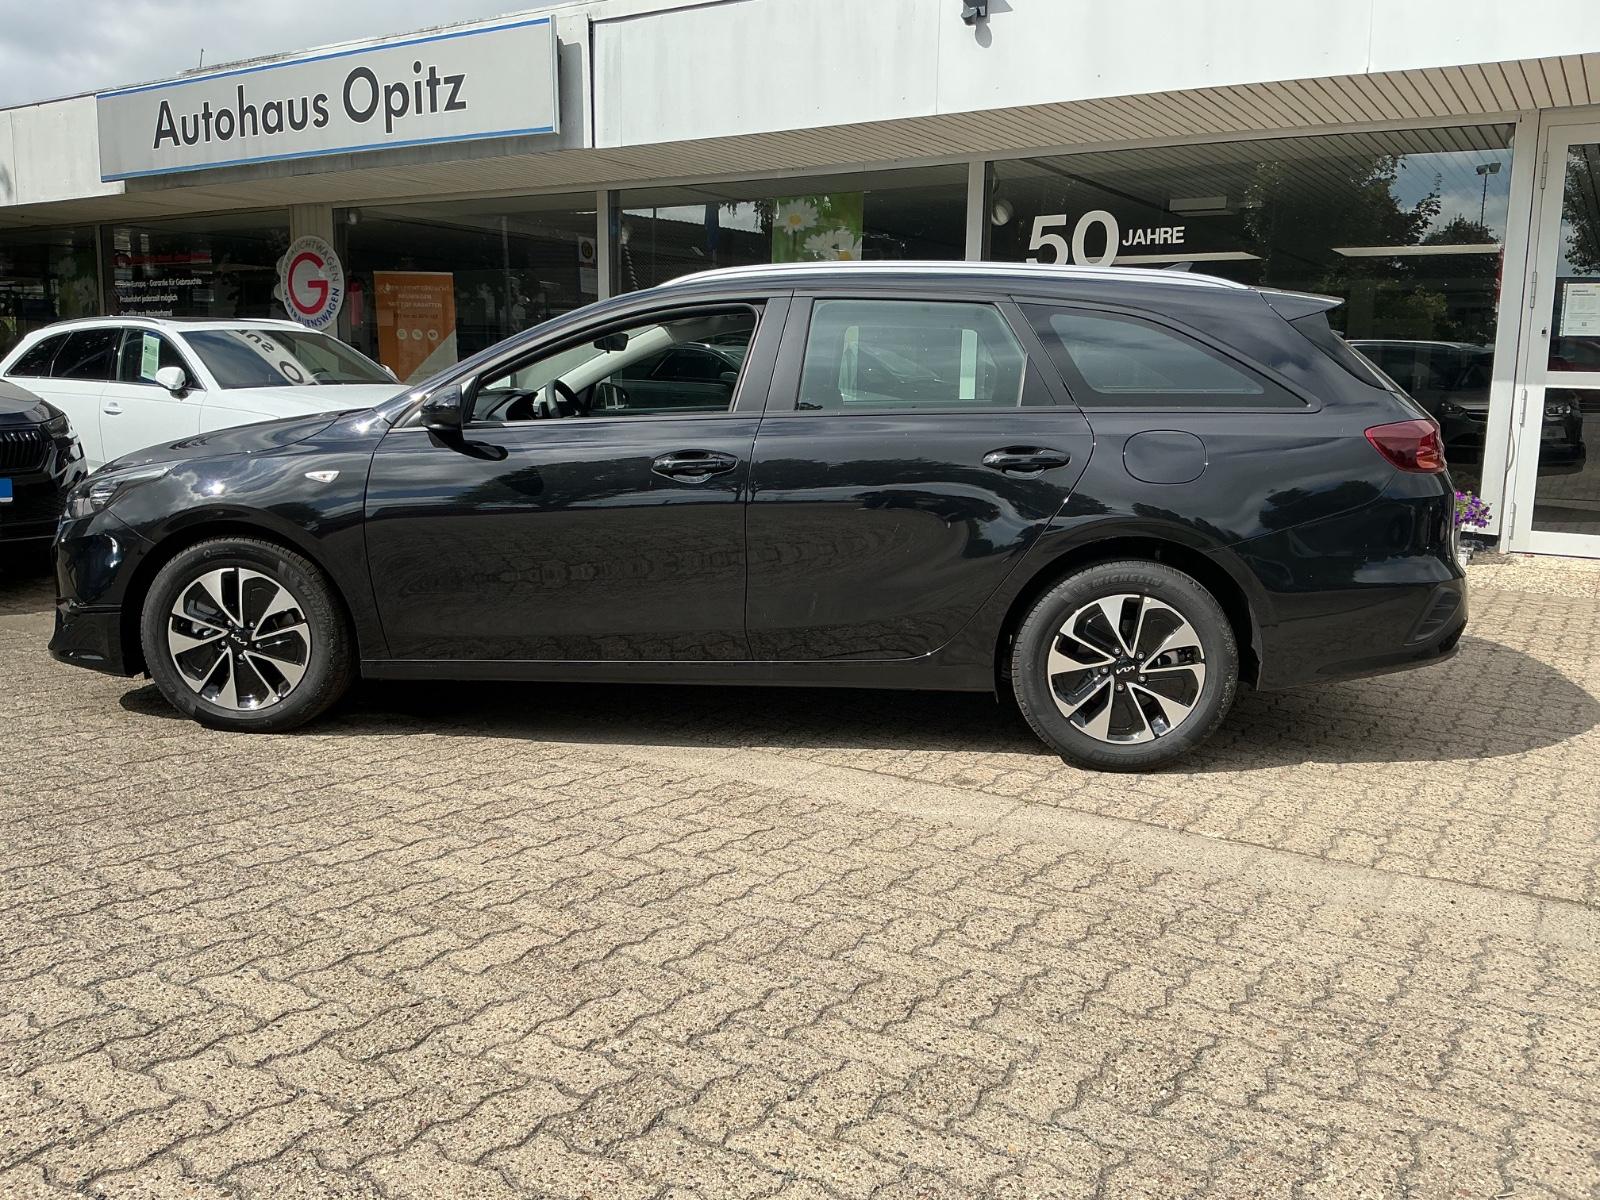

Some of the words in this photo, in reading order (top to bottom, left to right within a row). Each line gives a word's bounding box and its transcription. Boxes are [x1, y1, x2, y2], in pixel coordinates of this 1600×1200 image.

[153, 85, 329, 150] Autohaus
[343, 60, 468, 134] Opitz
[1026, 209, 1120, 266] 50
[1122, 226, 1185, 247] JAHRE
[287, 251, 329, 315] G
